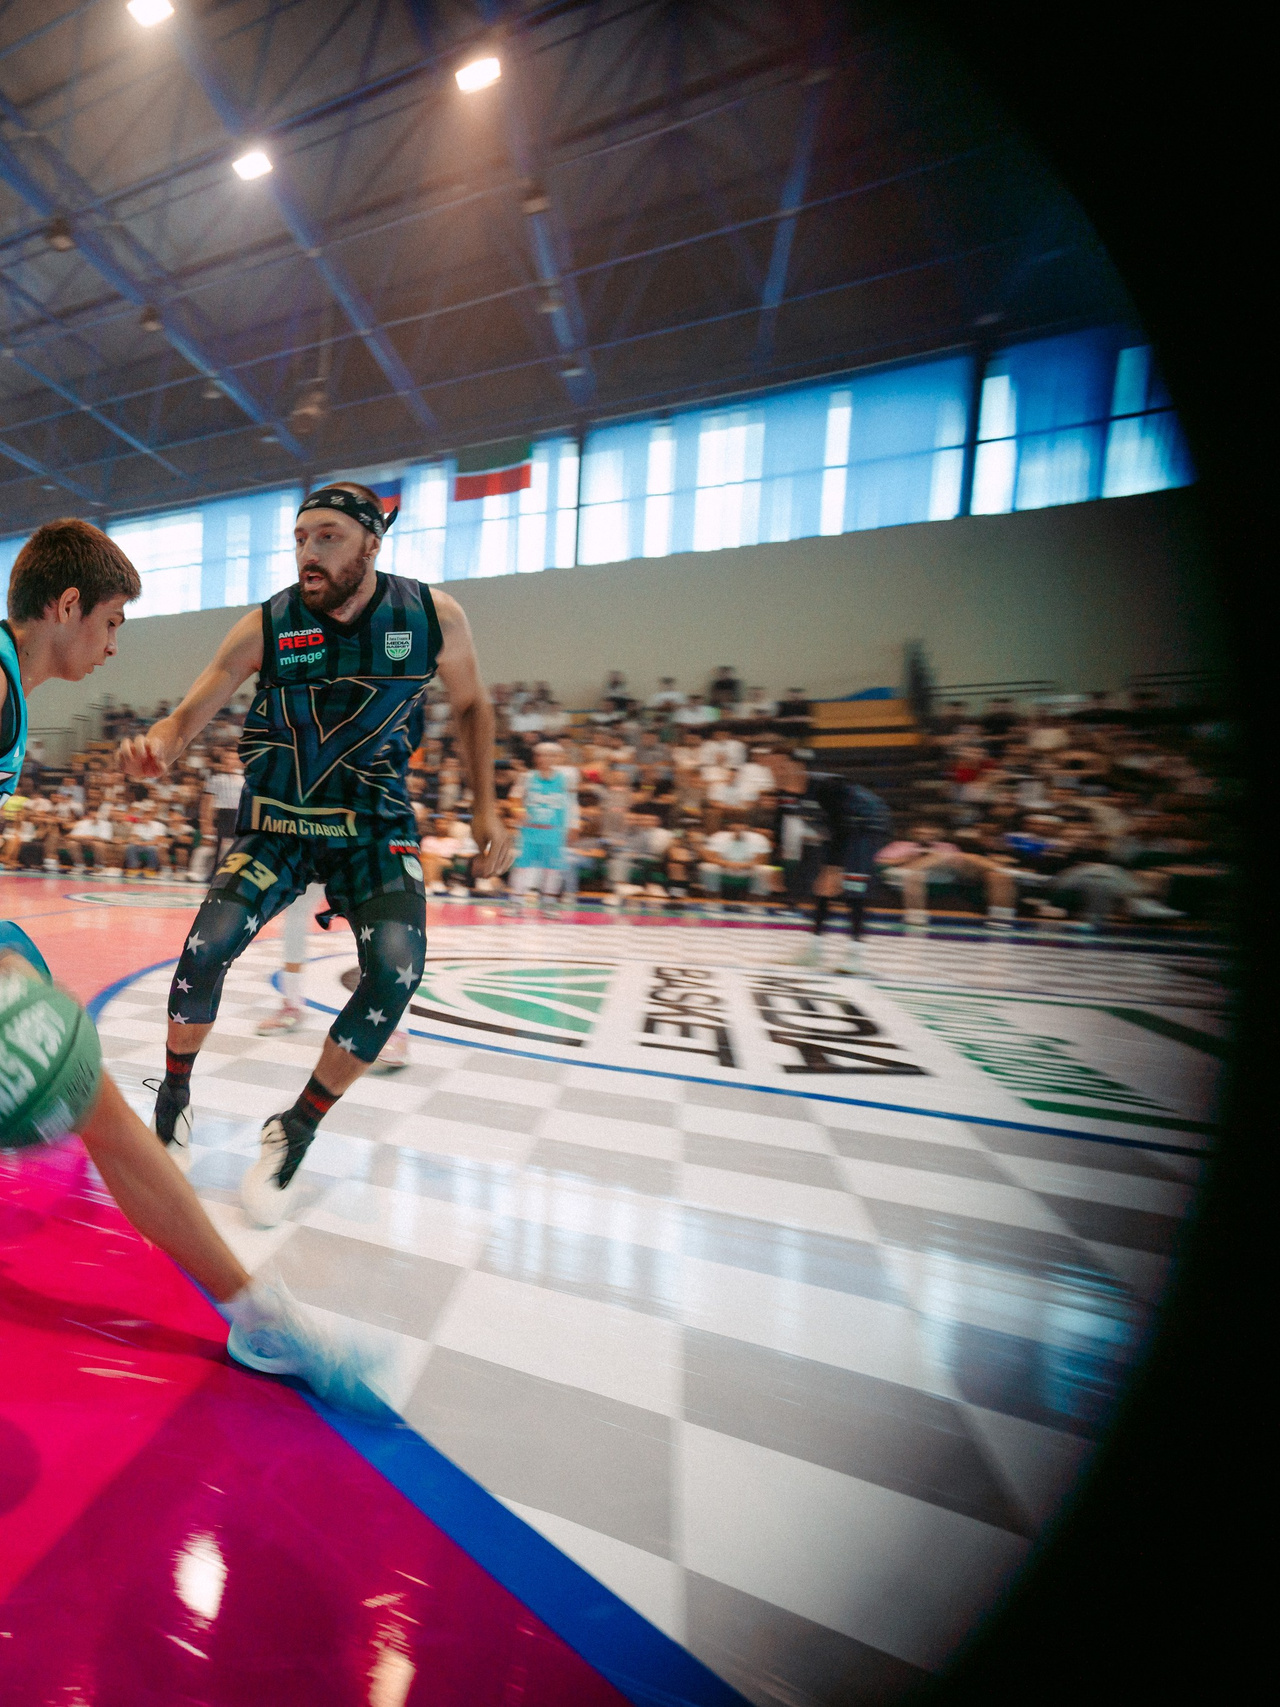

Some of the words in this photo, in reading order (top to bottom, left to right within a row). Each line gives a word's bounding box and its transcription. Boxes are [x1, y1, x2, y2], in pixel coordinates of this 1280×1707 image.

[278, 627, 322, 638] AMAZING
[278, 633, 325, 651] RED
[639, 965, 738, 1068] BASKET
[741, 973, 934, 1076] MEDIA
